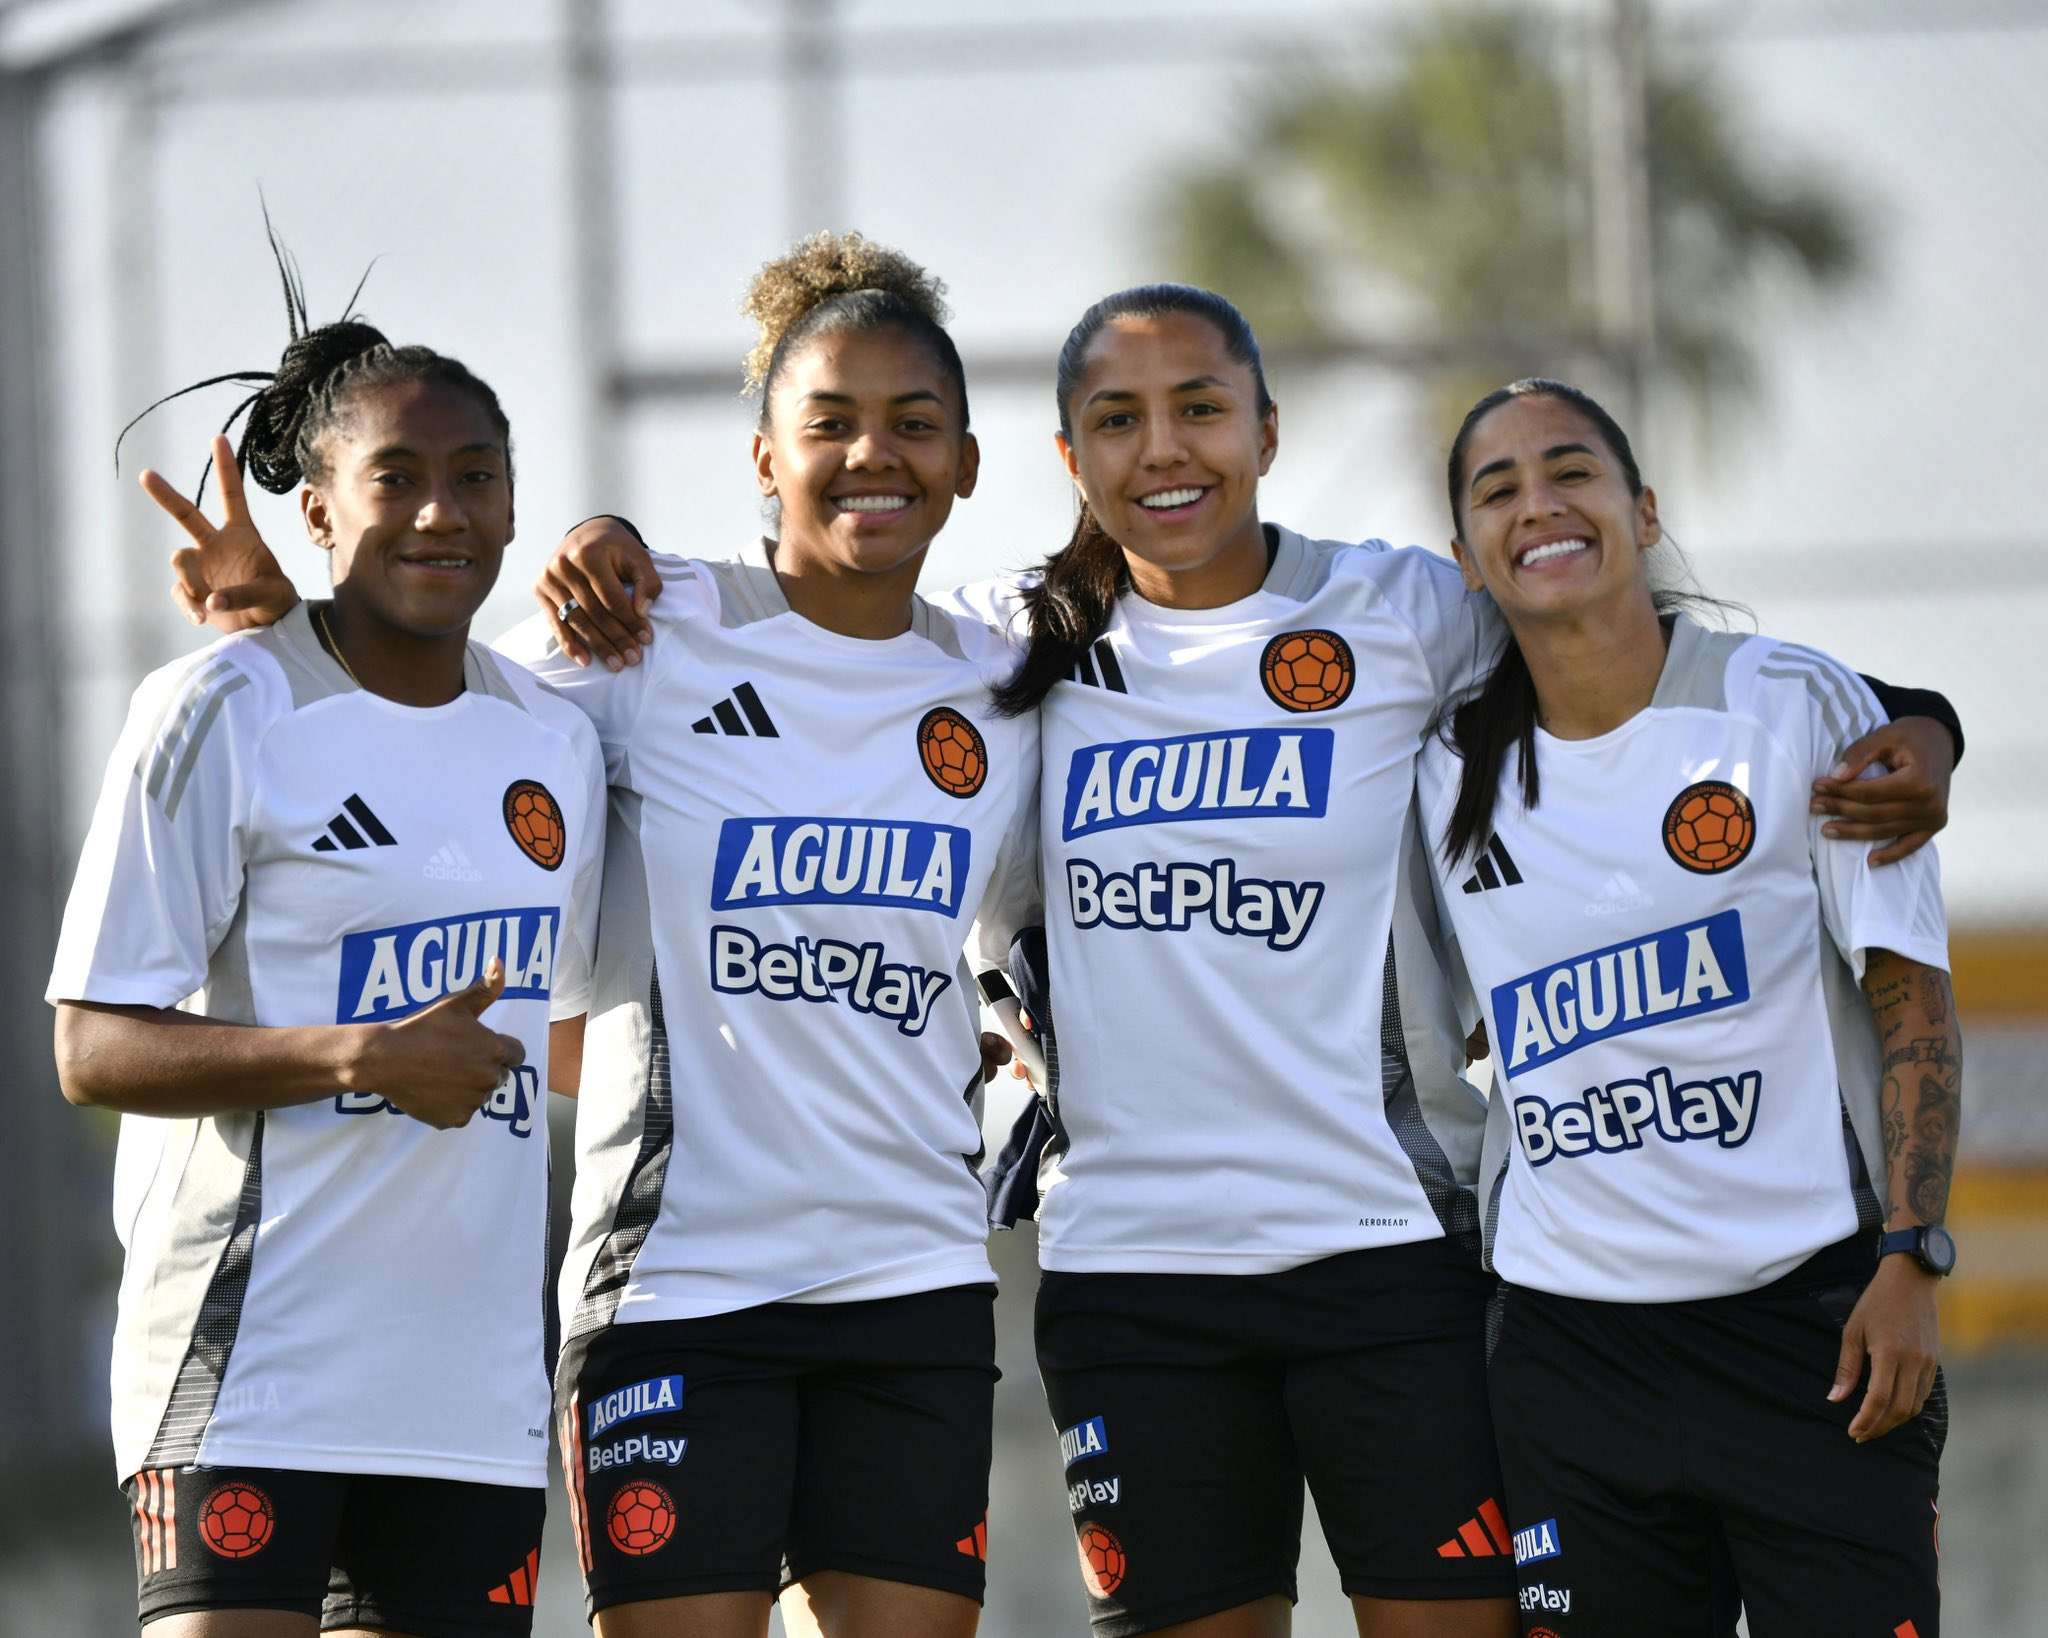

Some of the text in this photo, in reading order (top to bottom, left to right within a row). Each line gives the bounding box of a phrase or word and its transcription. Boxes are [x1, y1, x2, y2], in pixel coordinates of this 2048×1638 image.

[1071, 735, 1310, 831] AGUILA
[724, 823, 952, 908] AGUILA
[1066, 858, 1325, 952] BetPlay
[352, 915, 552, 1018] AGUILA
[710, 925, 952, 1037] BetPlay
[1508, 926, 1733, 1069] AGUILA
[1514, 1066, 1762, 1167] BetPlay
[1359, 1218, 1409, 1227] AEROREADY
[589, 1435, 687, 1474] BetPlay
[592, 1379, 676, 1436] AGUILA
